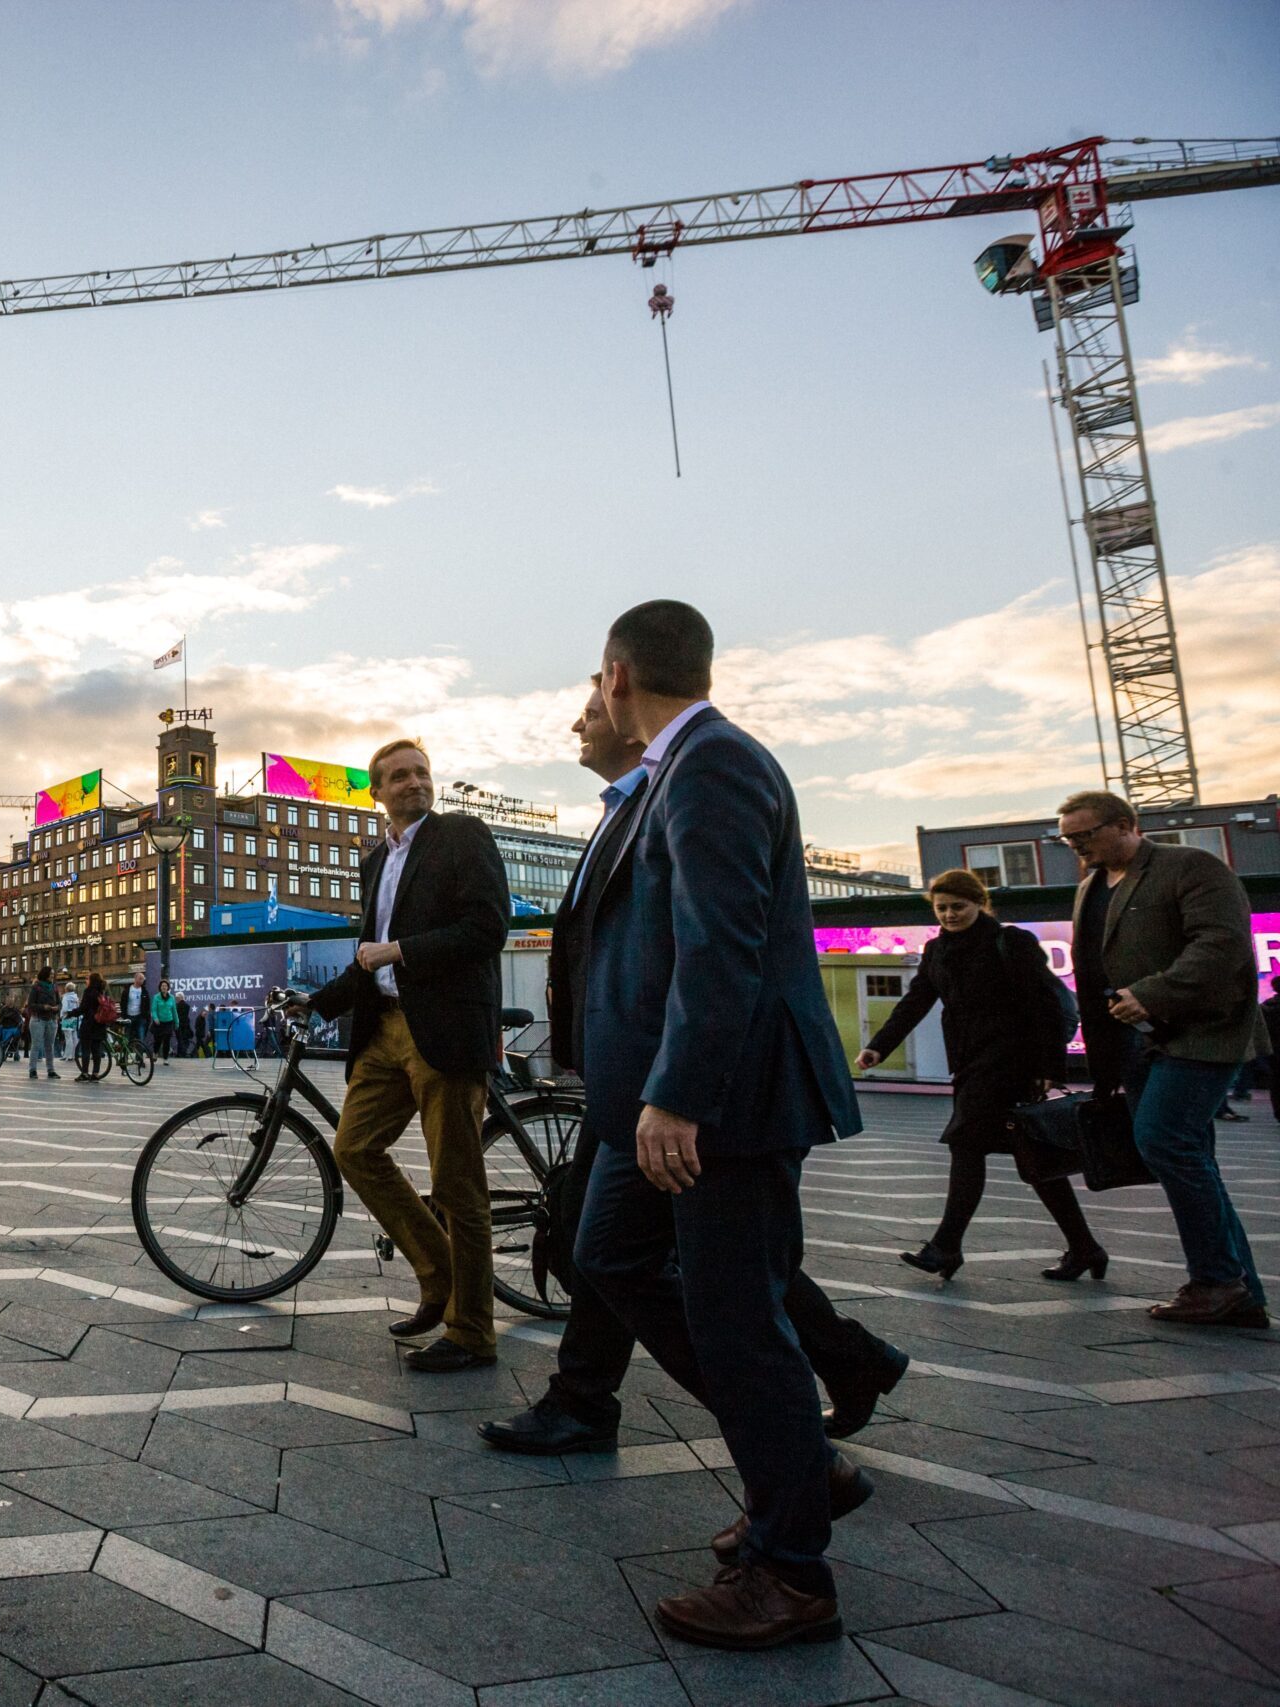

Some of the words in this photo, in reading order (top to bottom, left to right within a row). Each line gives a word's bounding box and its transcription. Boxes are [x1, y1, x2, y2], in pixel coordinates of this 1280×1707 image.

[176, 708, 213, 721] THAI
[120, 860, 137, 872] BDO
[523, 853, 537, 862] The
[540, 855, 566, 867] Square
[514, 940, 553, 948] RESTAU
[169, 974, 263, 992] FISKETORVET
[183, 994, 226, 1002] OPENHAGEN
[227, 992, 247, 1000] MALL
